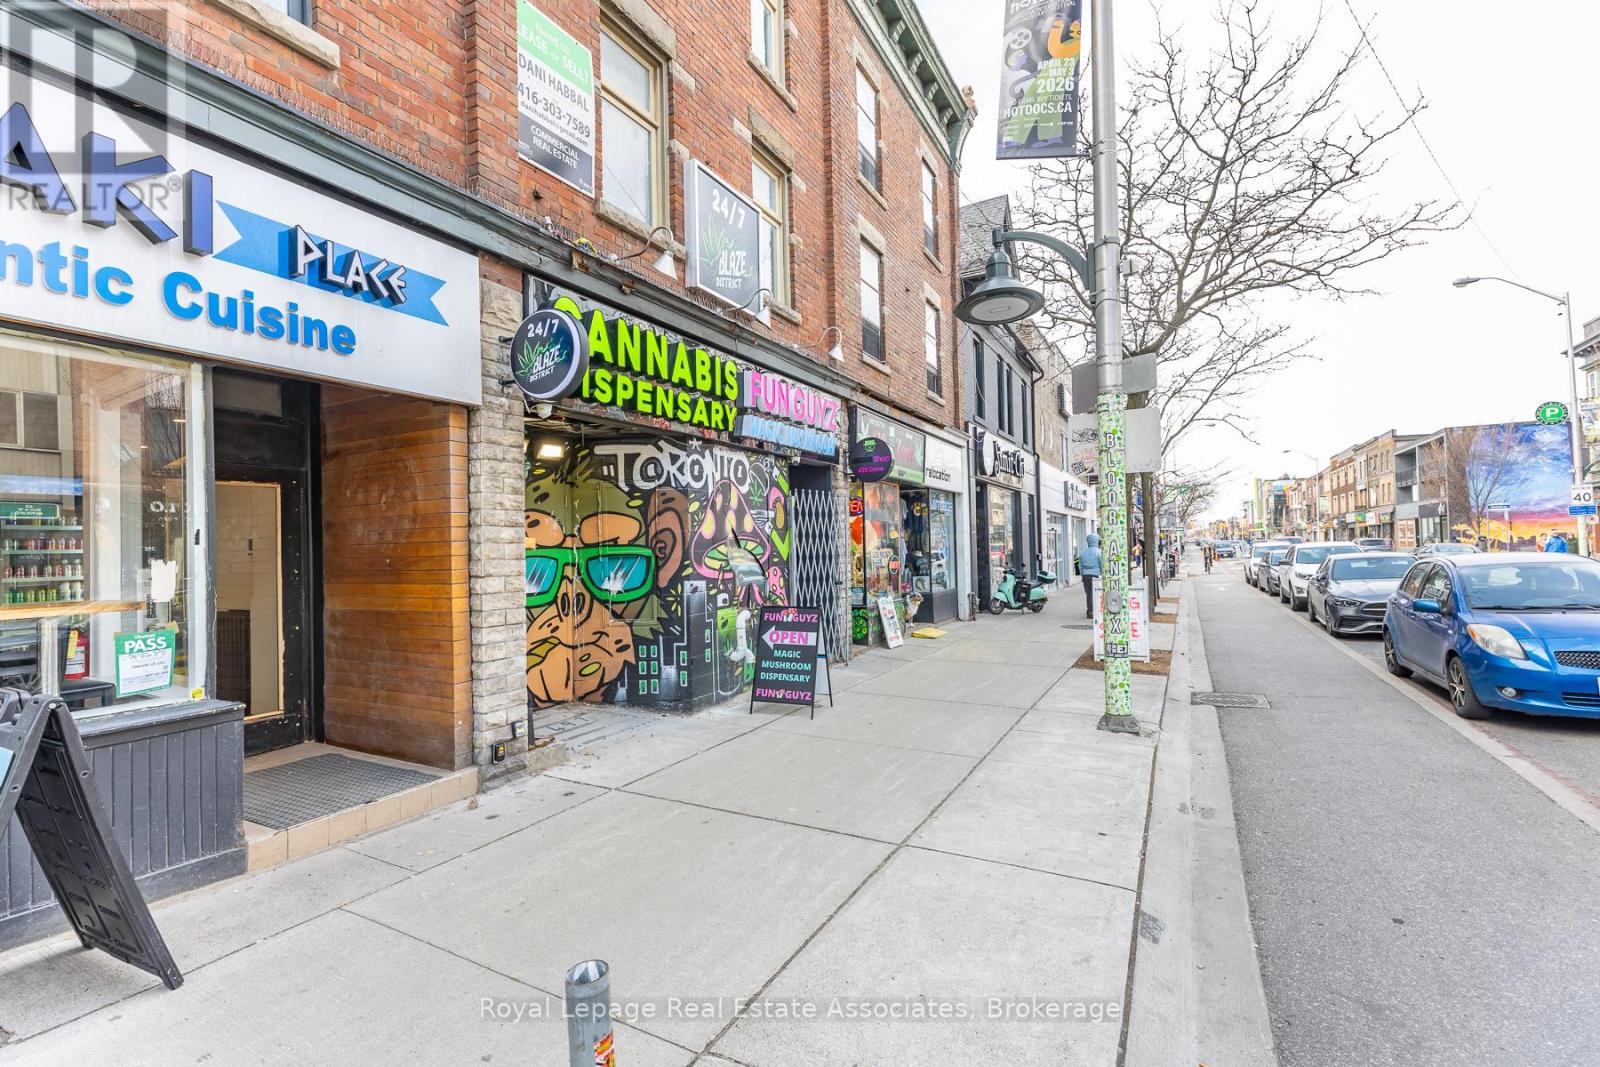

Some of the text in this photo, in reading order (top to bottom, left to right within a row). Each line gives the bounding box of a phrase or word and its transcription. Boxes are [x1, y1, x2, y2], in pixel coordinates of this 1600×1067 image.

[519, 23, 550, 55] EASE
[518, 53, 590, 112] DANI HABBAL
[1036, 76, 1075, 94] 2026
[517, 82, 591, 138] 416-303-7589
[1004, 101, 1073, 119] HOTDOCS.CA
[530, 124, 580, 160] COMMERCIAL
[532, 136, 553, 155] REAL
[553, 148, 579, 169] ESTATE
[711, 187, 746, 229] 24/7
[290, 224, 408, 304] PLACE
[715, 275, 742, 289] DISTRICT
[162, 270, 358, 356] Cuisine
[527, 318, 560, 338] 24/7
[529, 365, 556, 383] DISTRICT
[582, 366, 738, 432] ISPENSARY
[750, 370, 838, 433] FUN GUYZ
[1545, 407, 1560, 417] P
[593, 436, 751, 496] TORONTO
[1104, 432, 1119, 526] BLOOR
[1573, 492, 1592, 503] 40
[1107, 540, 1122, 635] ANNX
[763, 612, 819, 623] FUN GUYZ
[124, 636, 167, 653] PASS
[769, 630, 809, 645] OPEN
[773, 649, 802, 659] MAGIC
[761, 660, 812, 671] MUSHROOM
[760, 672, 811, 683] DISPENSARY
[755, 688, 812, 701] FUN GUYZ
